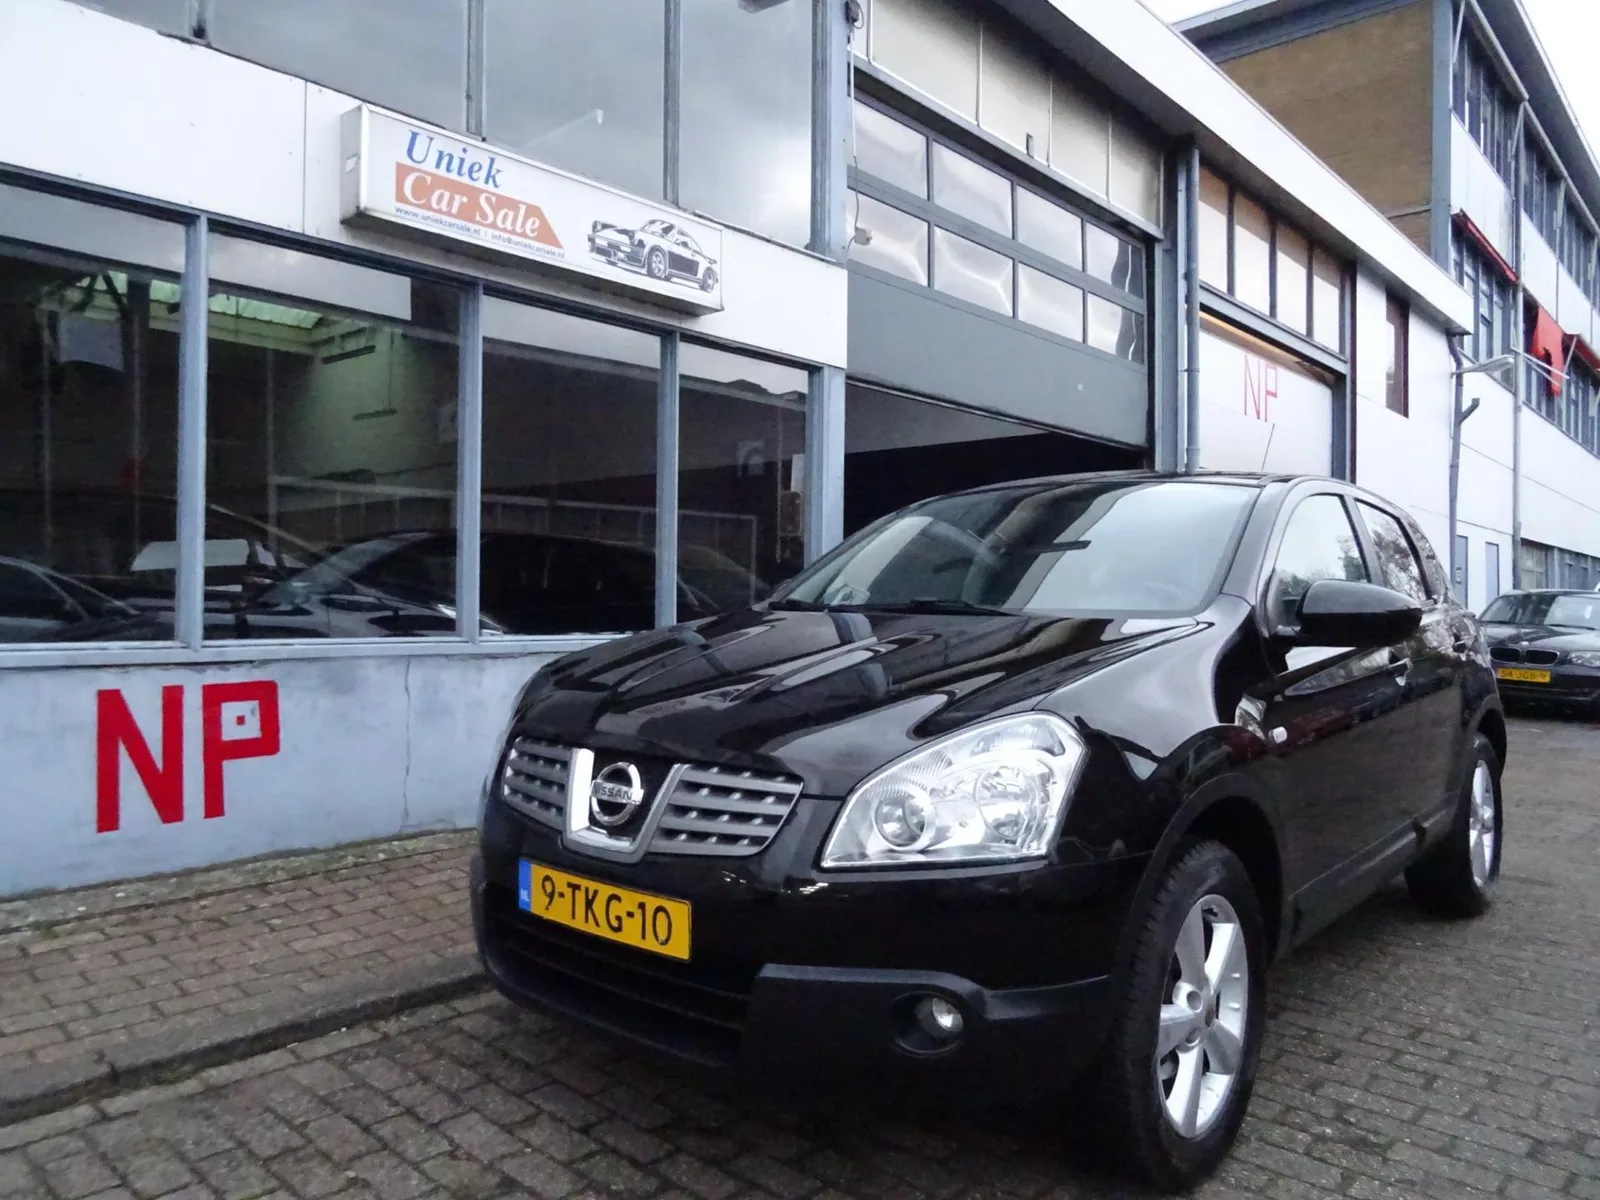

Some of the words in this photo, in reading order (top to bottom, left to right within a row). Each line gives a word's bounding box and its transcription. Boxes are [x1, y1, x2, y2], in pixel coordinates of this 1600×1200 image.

[406, 130, 503, 188] Uniek
[395, 206, 481, 236] www.uniekcarsale.nl
[404, 172, 467, 216] Car
[475, 194, 541, 236] Sale
[1244, 353, 1278, 423] NP
[97, 680, 280, 833] NP
[541, 874, 673, 946] 9-TKG-10
